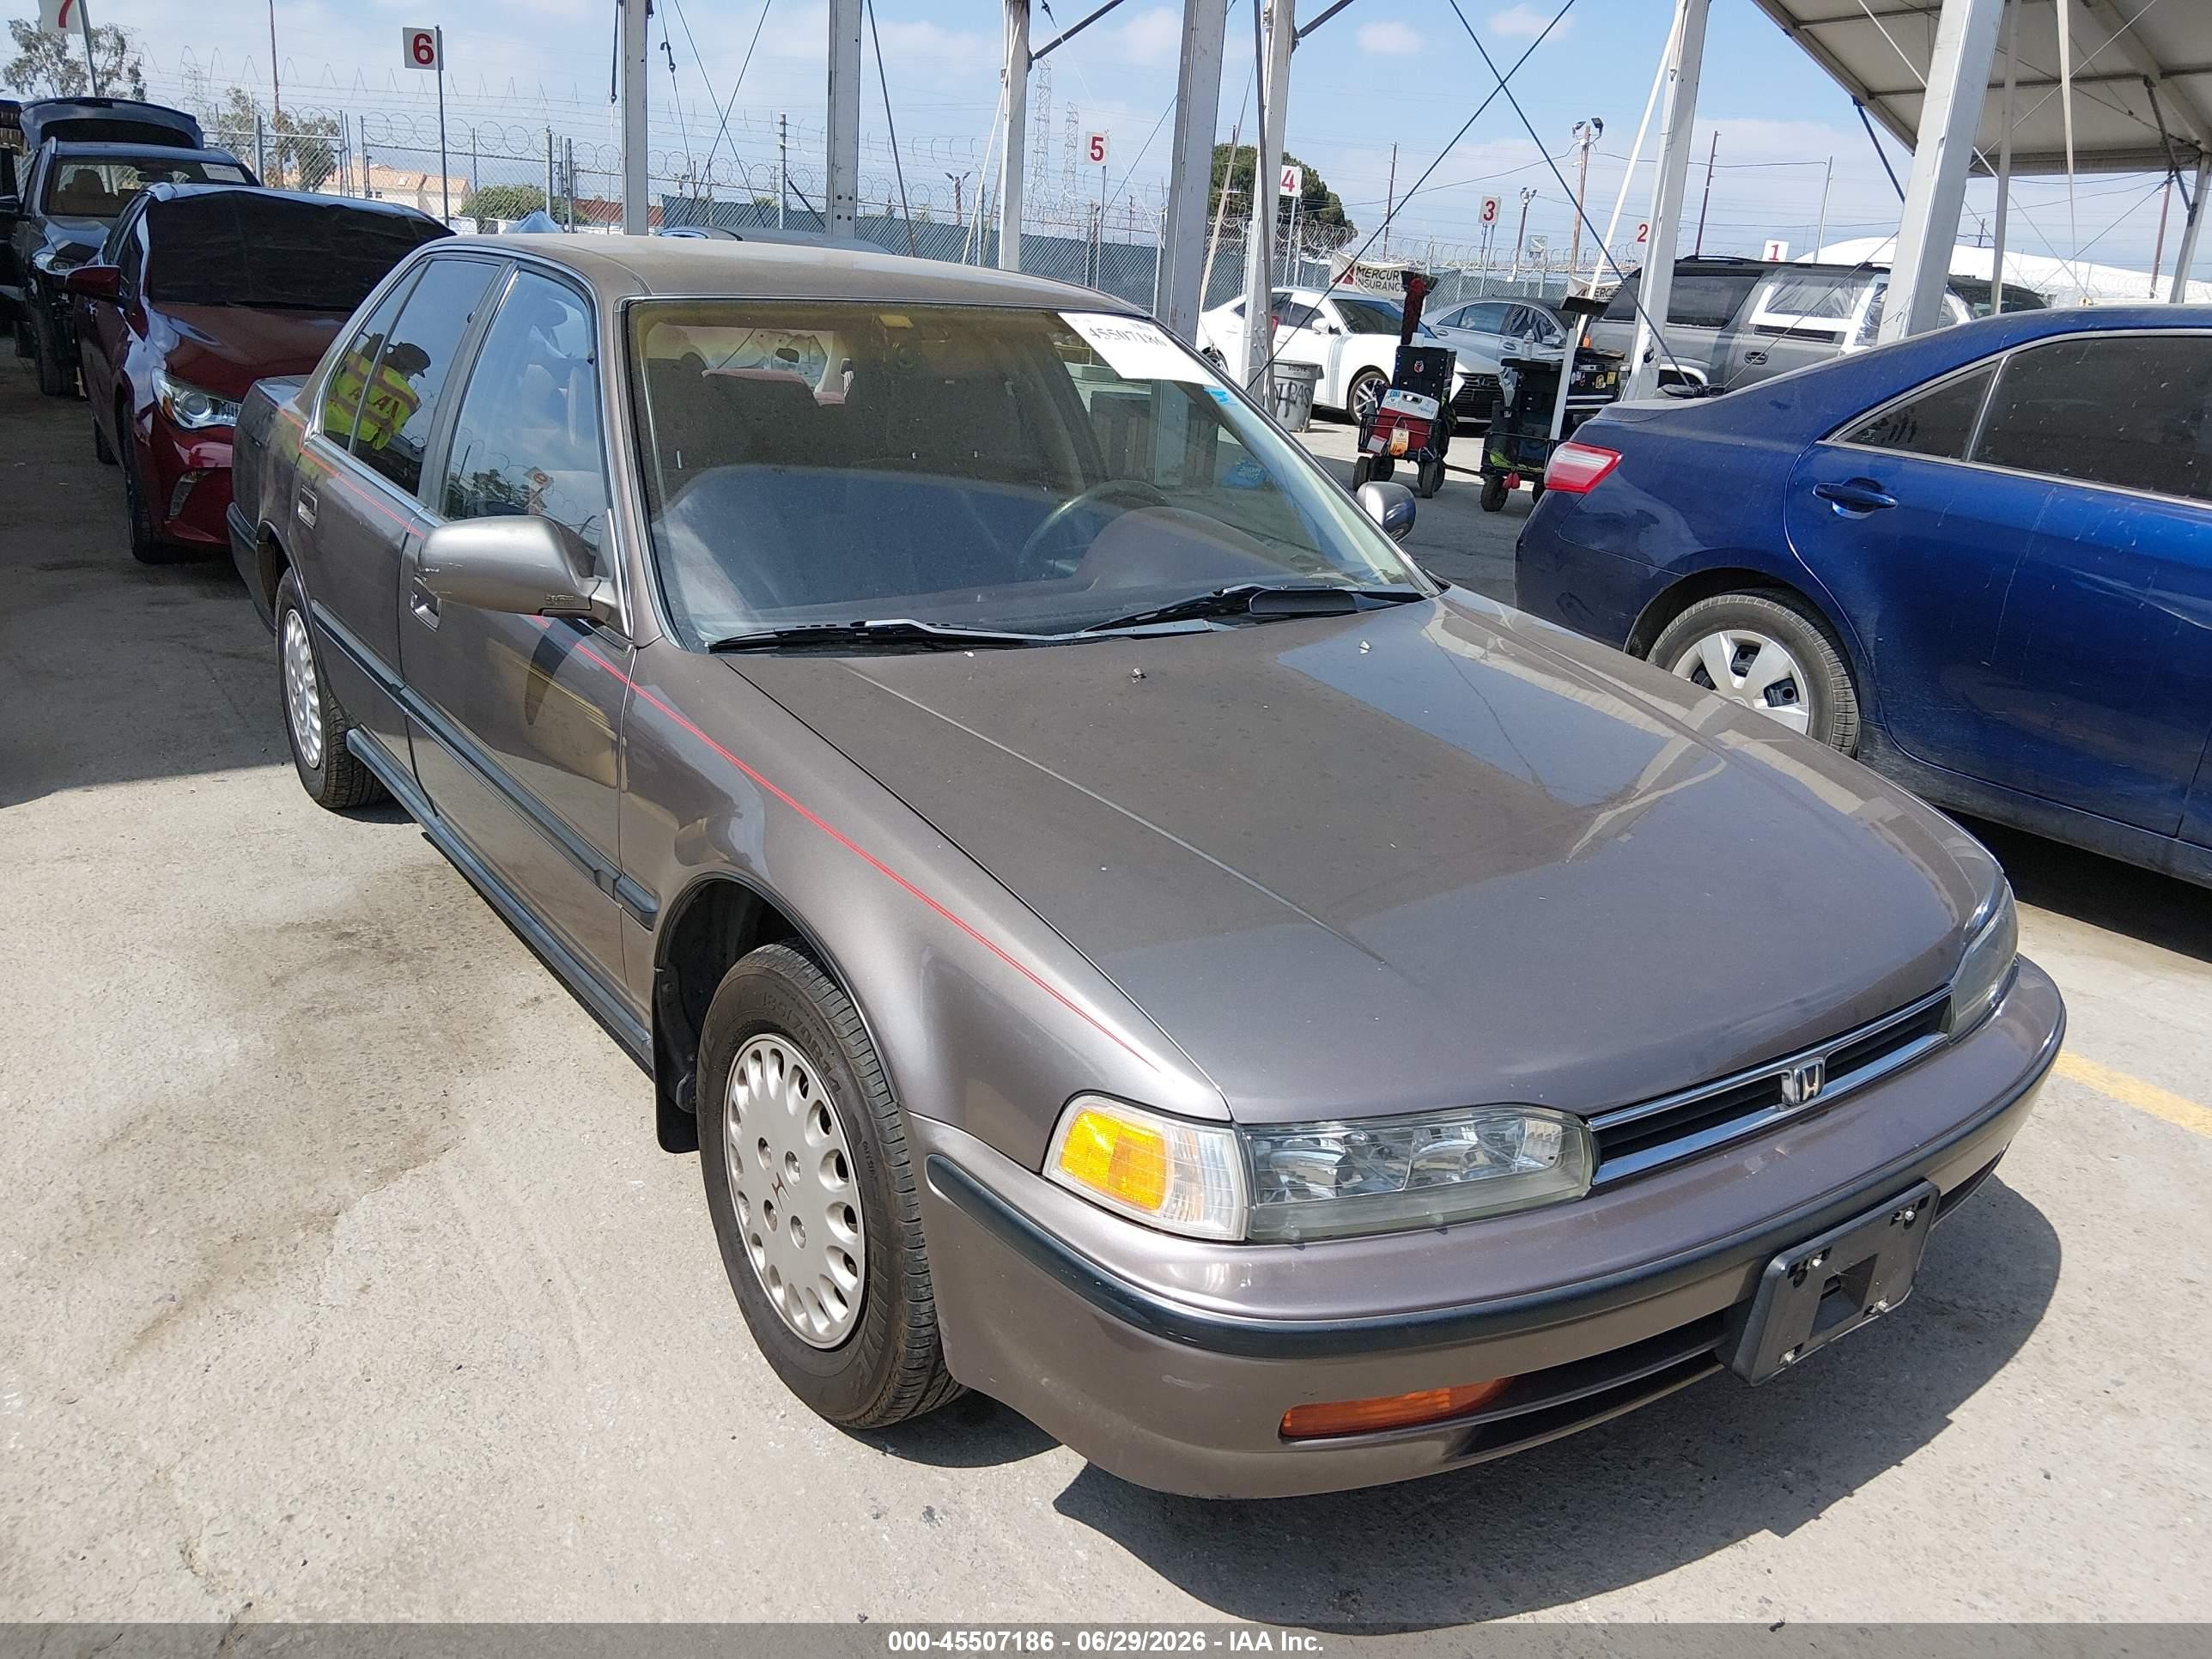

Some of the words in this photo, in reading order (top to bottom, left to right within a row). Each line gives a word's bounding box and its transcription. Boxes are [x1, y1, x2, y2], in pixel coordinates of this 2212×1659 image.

[413, 33, 434, 65] 6
[1090, 136, 1104, 161] 5
[1281, 169, 1295, 193] 4
[1483, 200, 1496, 222] 3
[1637, 223, 1649, 242] 2
[1768, 244, 1779, 261] 1
[1356, 265, 1400, 282] MERCUR
[1355, 277, 1401, 293] INSURANC
[1275, 381, 1314, 418] TRAS
